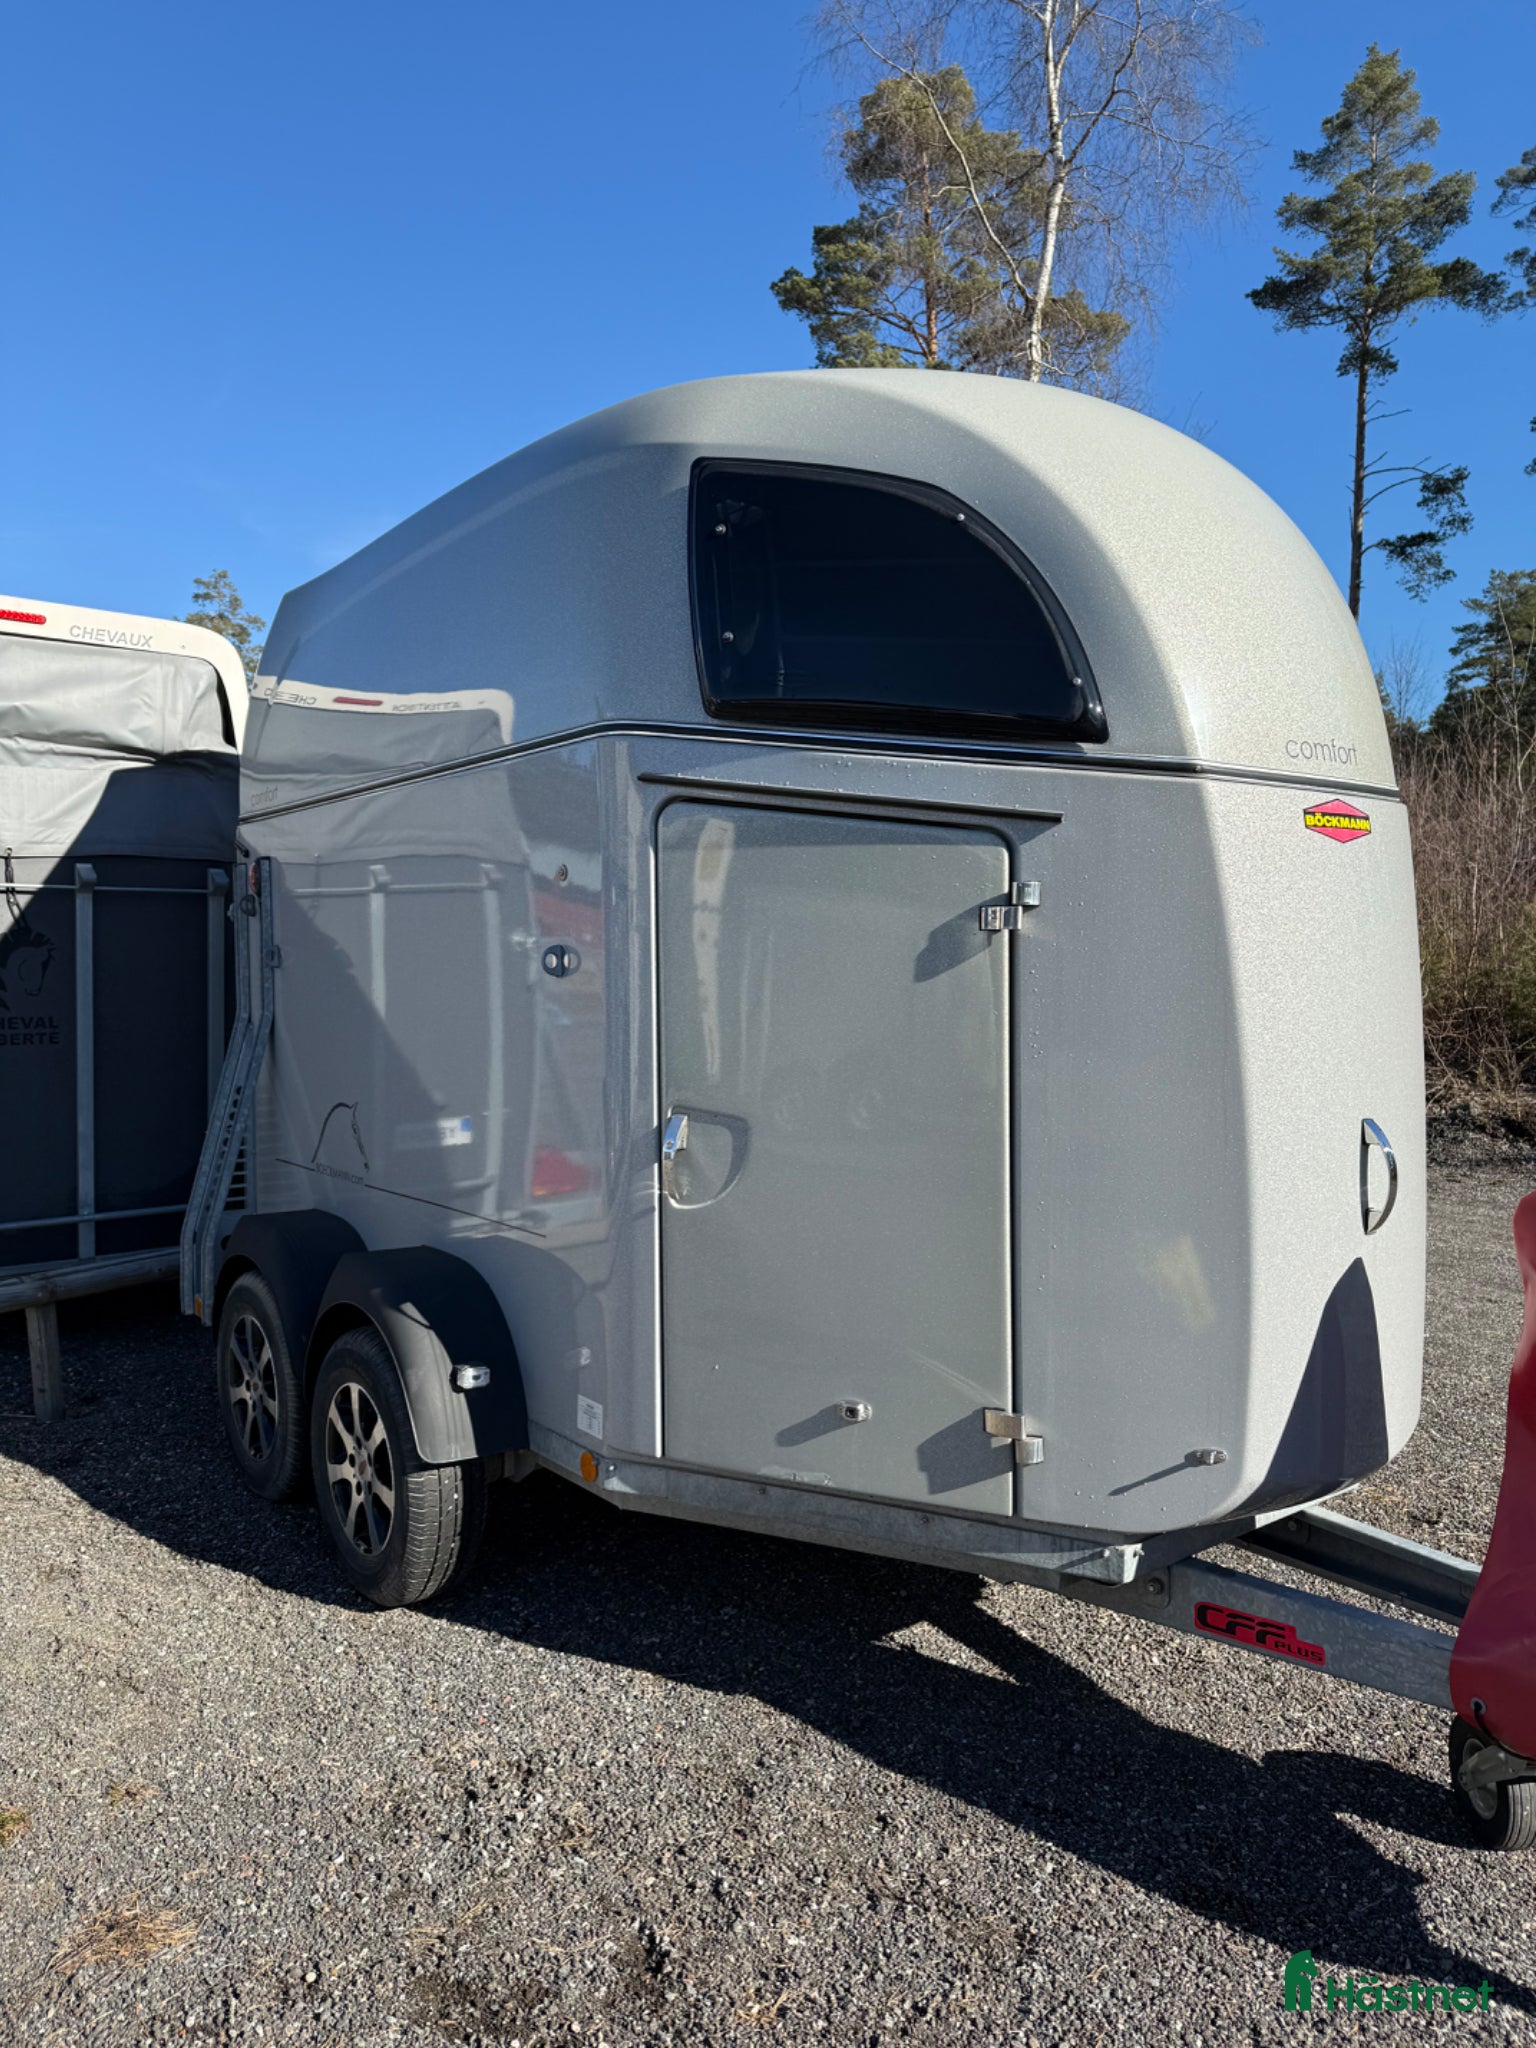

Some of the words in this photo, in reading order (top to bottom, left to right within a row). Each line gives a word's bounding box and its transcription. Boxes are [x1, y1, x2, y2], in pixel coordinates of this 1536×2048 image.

[69, 624, 153, 648] CHEVAUX
[1285, 738, 1359, 766] comfort
[1305, 813, 1370, 832] BÖCKMANN
[1274, 1640, 1323, 1663] PLUS
